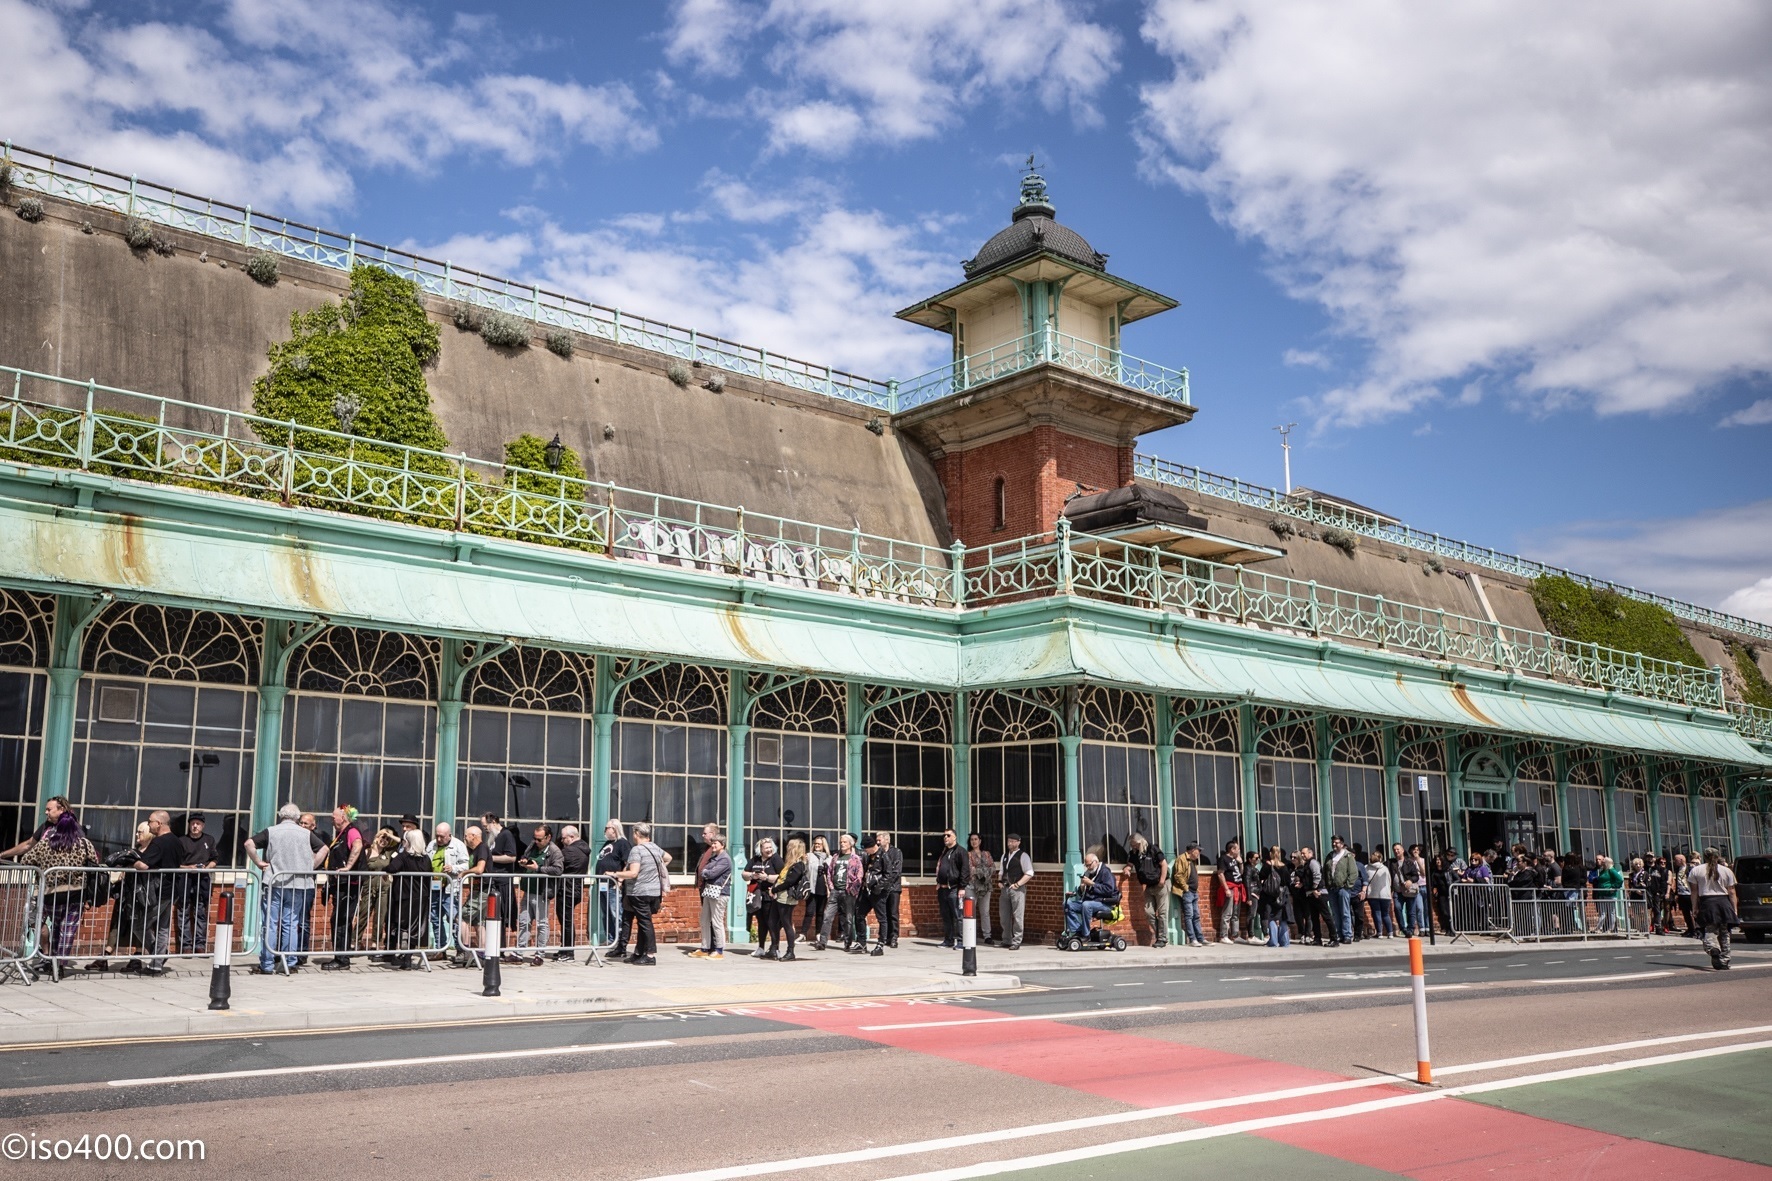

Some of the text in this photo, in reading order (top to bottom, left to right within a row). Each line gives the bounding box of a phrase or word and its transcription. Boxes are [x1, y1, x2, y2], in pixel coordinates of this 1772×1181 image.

[637, 995, 996, 1022] LOOK BOTH WAYS
